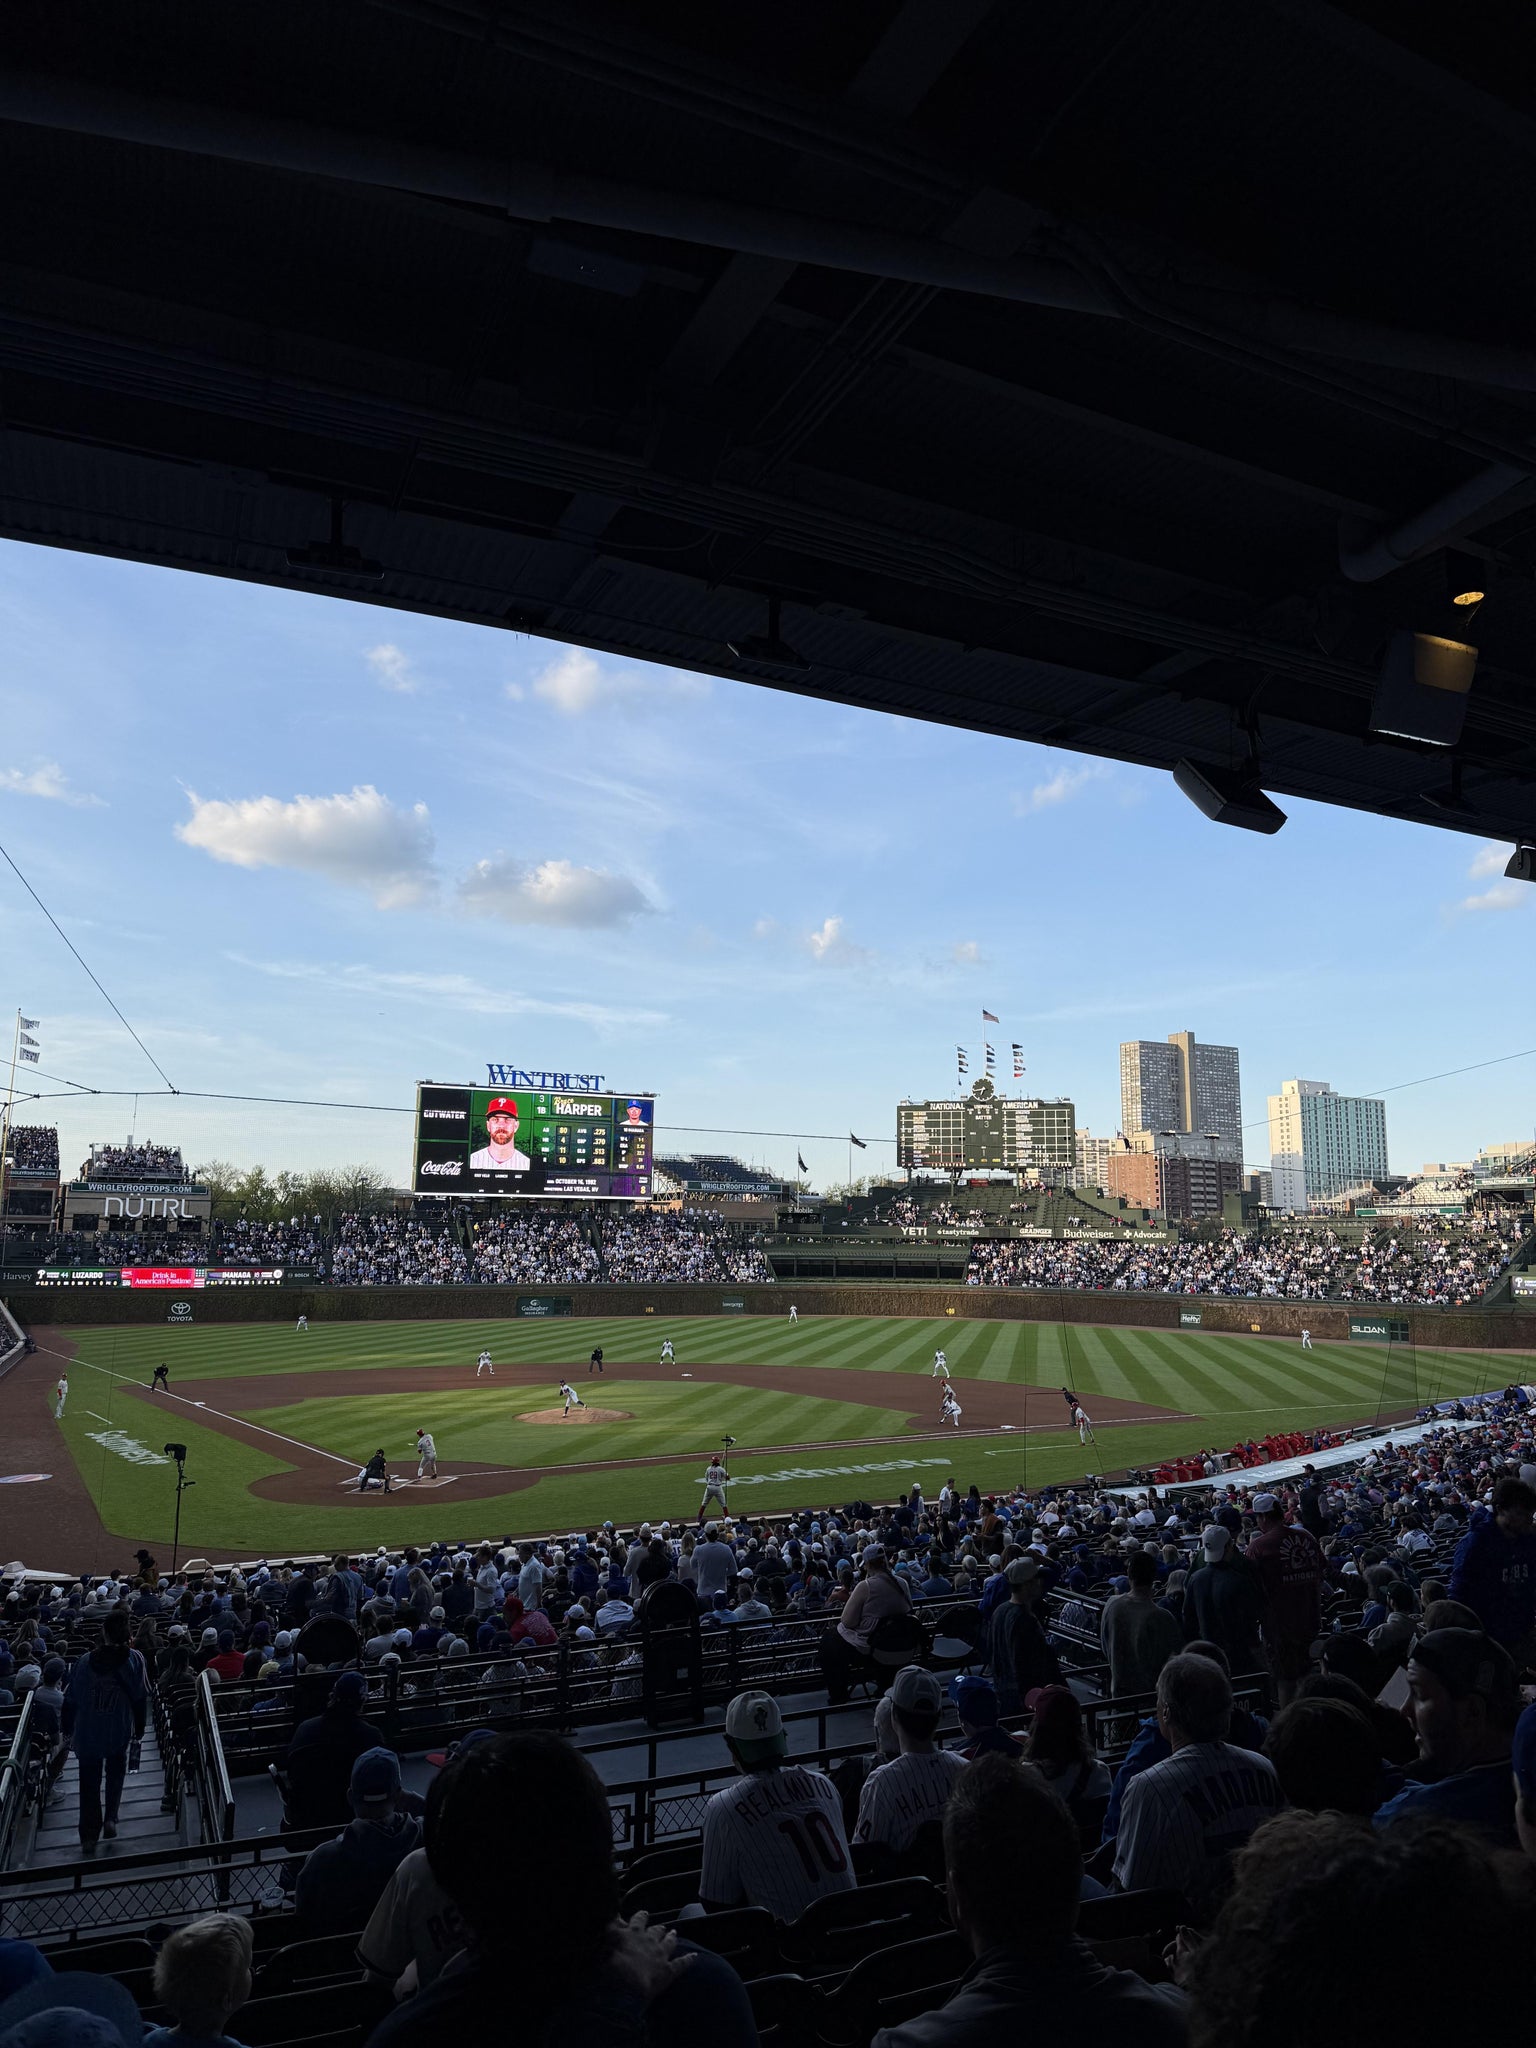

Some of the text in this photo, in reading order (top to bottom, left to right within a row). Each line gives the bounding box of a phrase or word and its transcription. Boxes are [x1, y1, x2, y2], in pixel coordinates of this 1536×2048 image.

[486, 1063, 606, 1091] WINTRUST
[556, 1103, 602, 1116] HARPER
[1002, 1101, 1039, 1109] AMERICAN
[984, 1120, 989, 1128] 3
[420, 1160, 464, 1176] Coca-Cola
[88, 1183, 192, 1194] WRIGLEYROOFTOPS.COM
[640, 1186, 646, 1194] 8
[700, 1182, 770, 1192] WRIGLEYROOFTOPS.COM
[794, 1206, 813, 1214] Mobile
[900, 1227, 928, 1236] YETI
[943, 1228, 980, 1236] tastytrade
[1062, 1229, 1113, 1238] Budweiser
[1133, 1230, 1167, 1239] Advocate
[2, 1272, 32, 1281] Harvey
[72, 1271, 103, 1279] LUZARDO
[1181, 1315, 1200, 1323] Hefty
[1352, 1325, 1384, 1334] SLOAN
[734, 1774, 834, 1826] REALMUTO
[895, 1777, 951, 1820] HALL
[778, 1811, 847, 1883] 10
